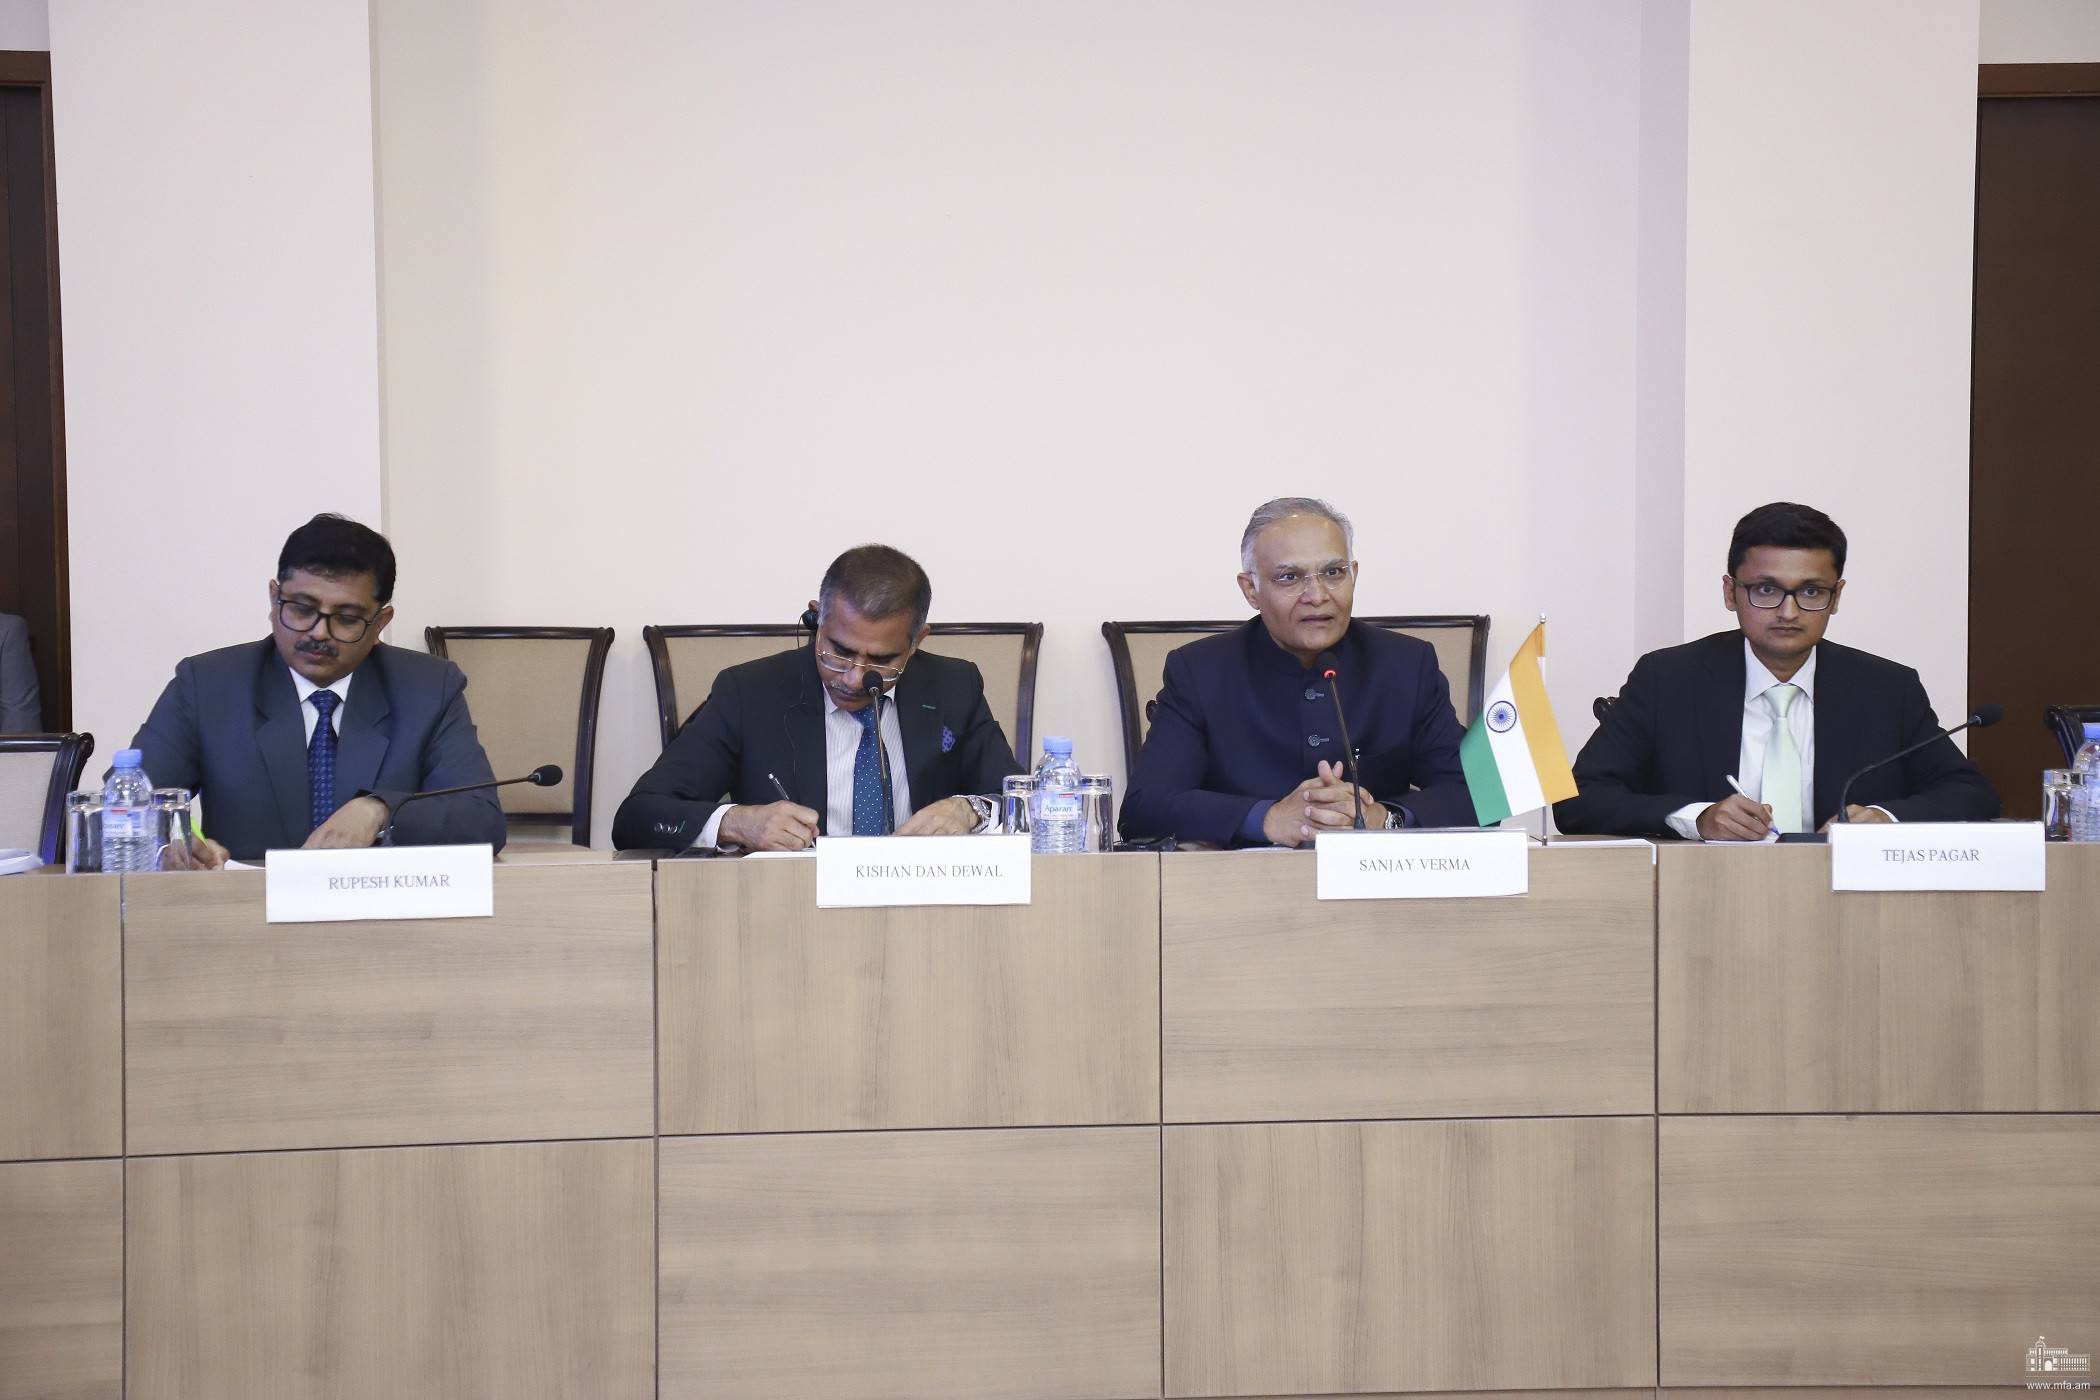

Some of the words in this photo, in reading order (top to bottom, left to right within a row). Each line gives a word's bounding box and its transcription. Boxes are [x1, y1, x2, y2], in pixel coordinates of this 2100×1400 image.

[1882, 849, 1925, 864] TEJAS
[1929, 849, 1980, 862] PAGAR
[855, 865, 911, 878] KISHAN
[916, 865, 947, 878] DAN
[952, 864, 1003, 878] DEWAL
[1359, 858, 1414, 872] SANJAY
[1419, 858, 1470, 871] VERMA
[328, 875, 389, 890] RUPESH
[394, 874, 450, 888] KUMAR
